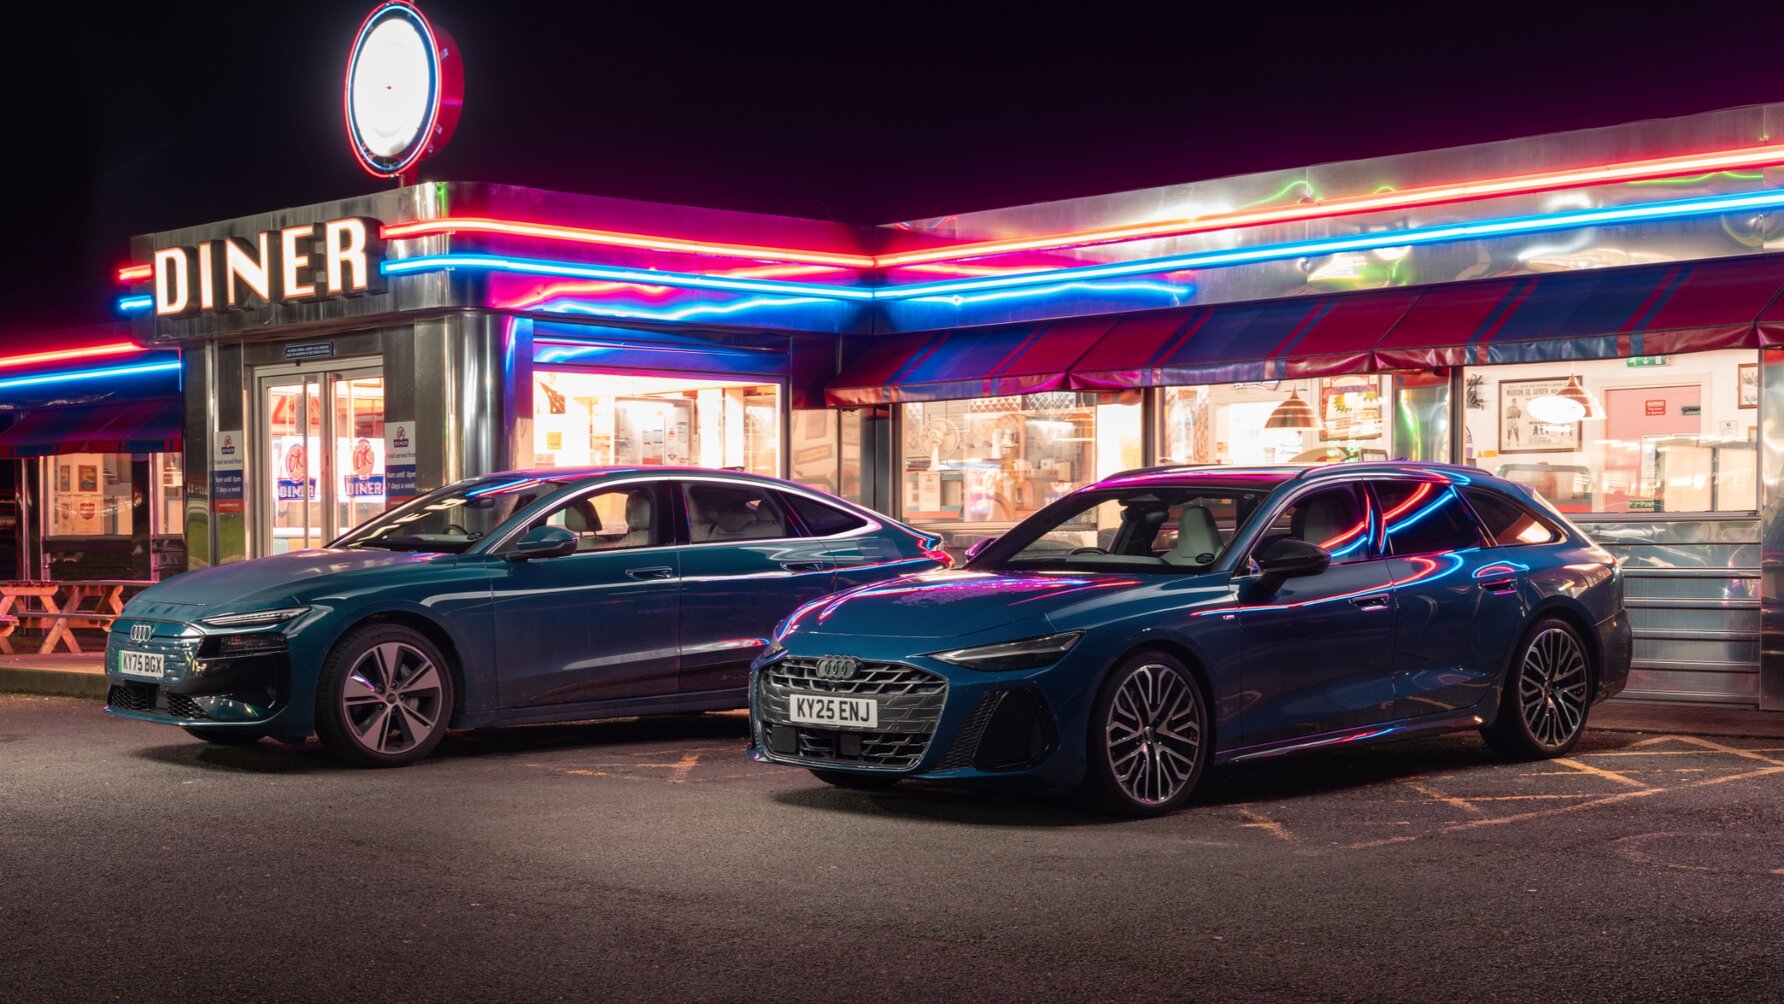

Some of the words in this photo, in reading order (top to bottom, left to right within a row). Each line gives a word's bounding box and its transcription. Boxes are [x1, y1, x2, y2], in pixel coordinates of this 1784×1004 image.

[155, 217, 368, 316] DINER
[356, 445, 372, 470] OK
[219, 486, 228, 494] days
[346, 482, 383, 496] DINER
[123, 652, 143, 671] KY75
[144, 654, 162, 673] BGX
[796, 698, 835, 720] KY25
[839, 700, 870, 722] ENJ
